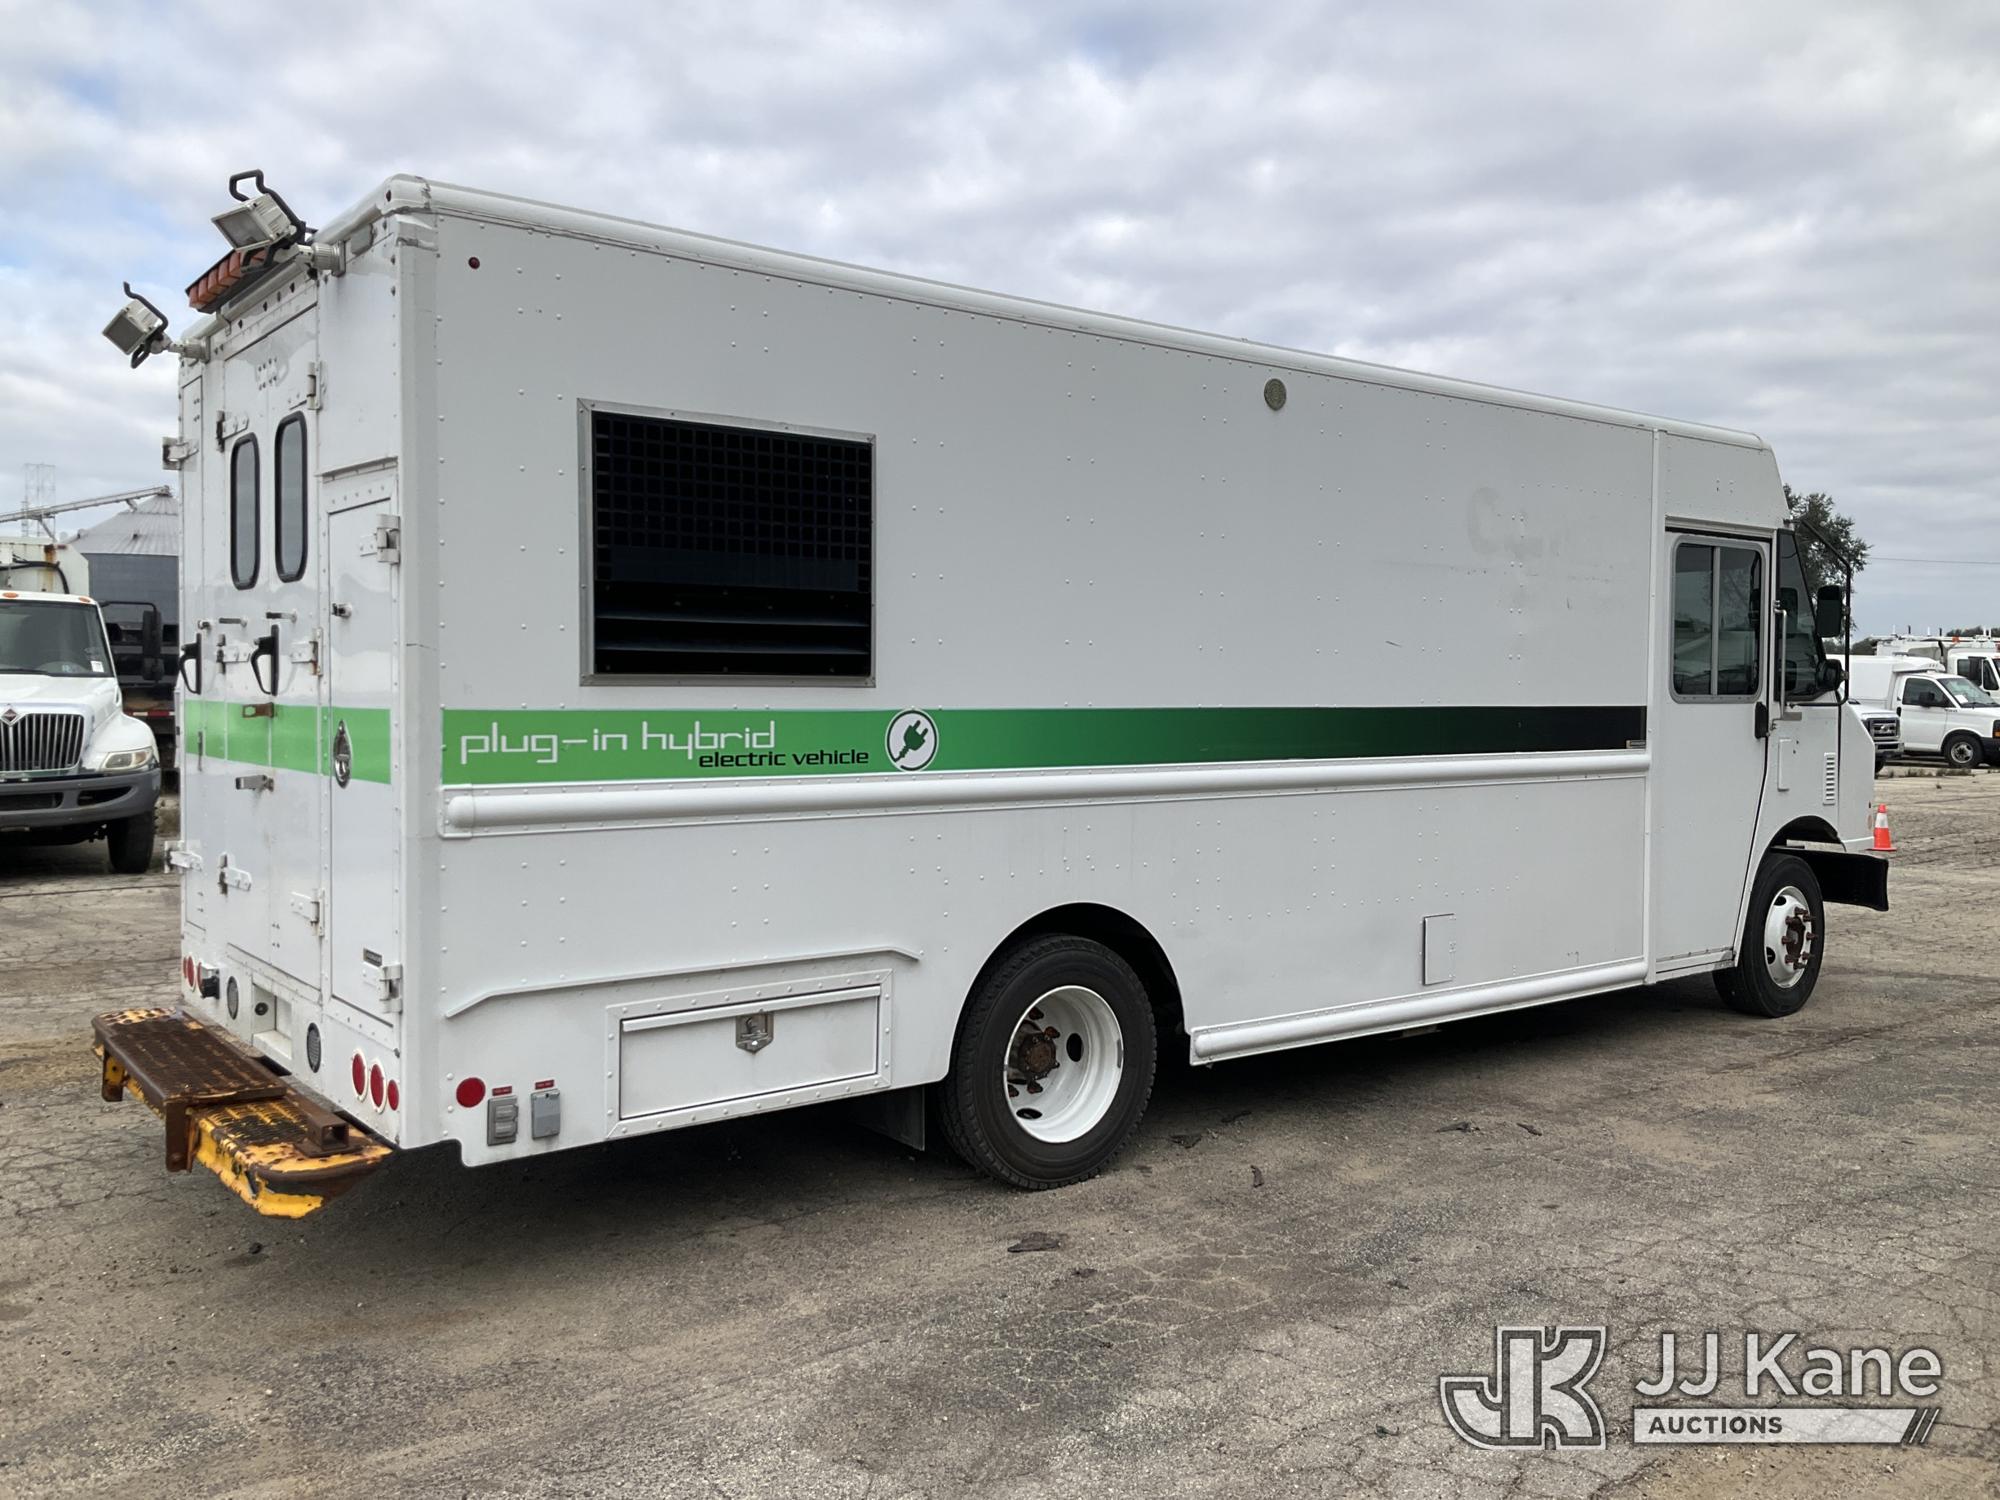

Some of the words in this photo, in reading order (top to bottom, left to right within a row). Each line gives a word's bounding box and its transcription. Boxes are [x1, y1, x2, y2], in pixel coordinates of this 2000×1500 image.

[460, 721, 628, 765] plug-in
[641, 720, 775, 761] hybrid
[699, 750, 786, 768] electric
[793, 749, 869, 766] vehicle
